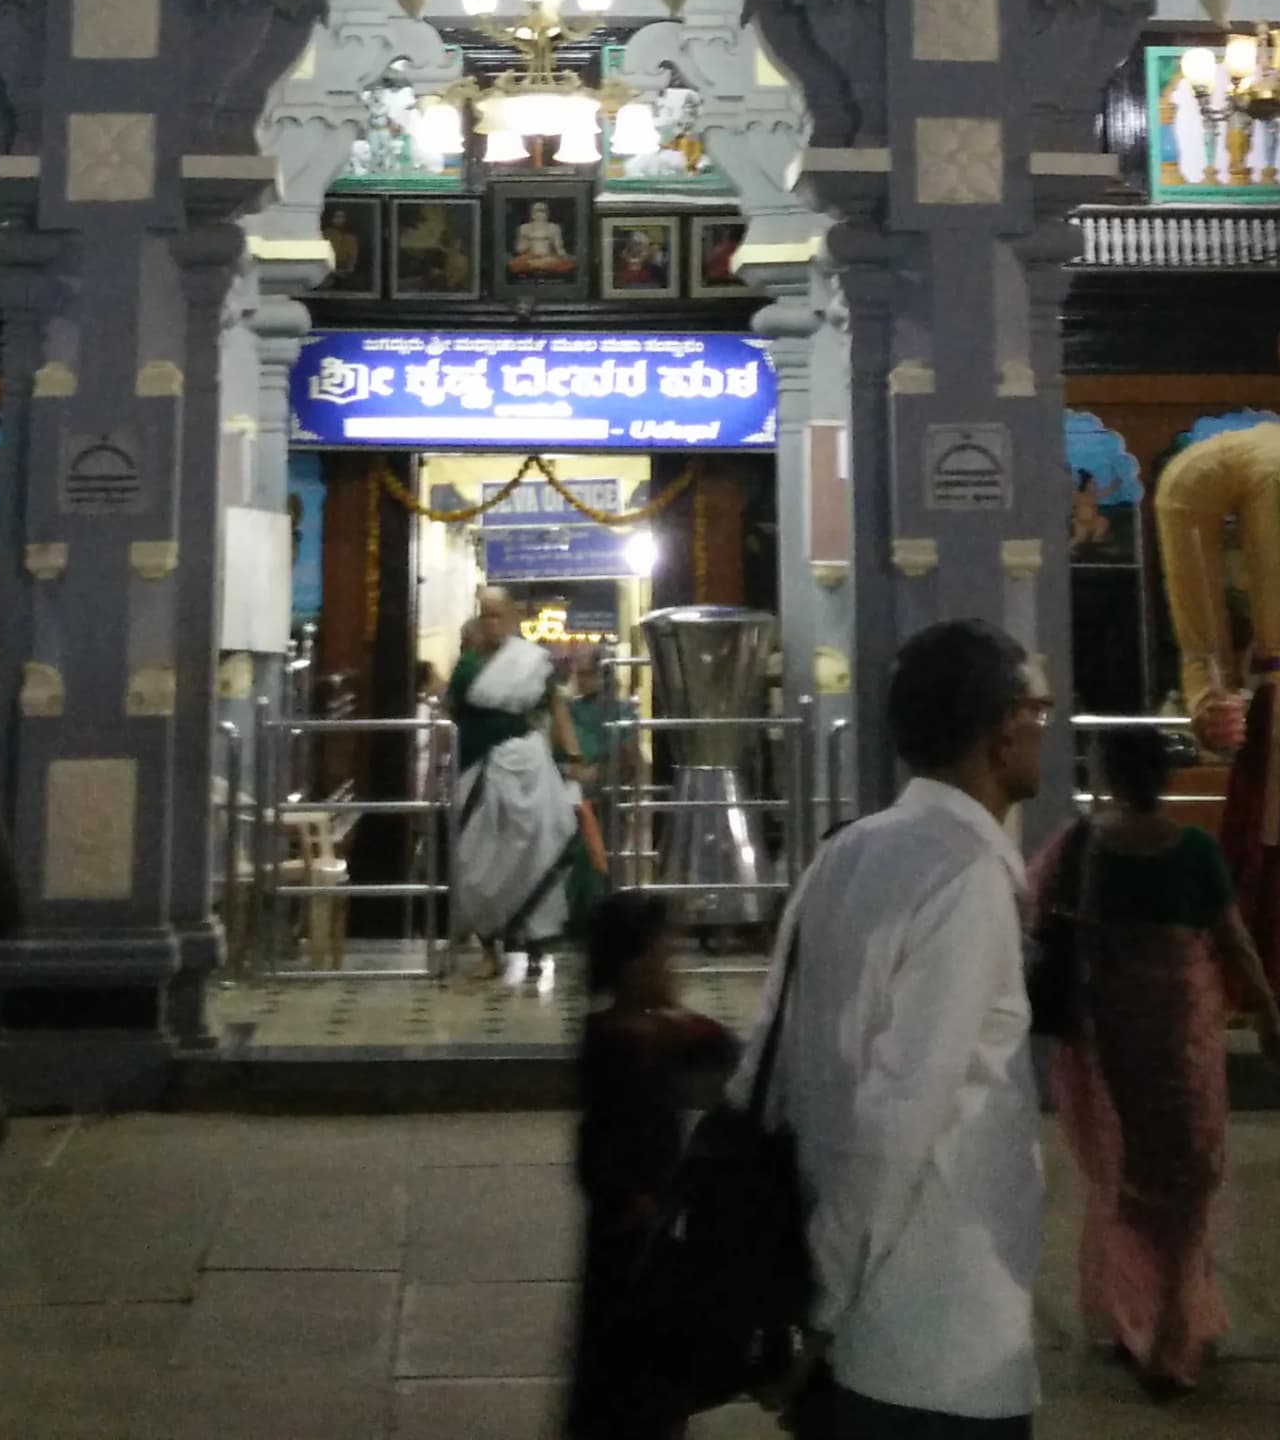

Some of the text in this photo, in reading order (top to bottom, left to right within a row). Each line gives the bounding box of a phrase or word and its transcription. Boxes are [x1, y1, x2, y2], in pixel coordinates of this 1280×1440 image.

[308, 356, 759, 410] ಶ್ರೀ ಕೃಷ್ಣ ದೇವರ ಮಠ
[628, 418, 722, 443] Udupi
